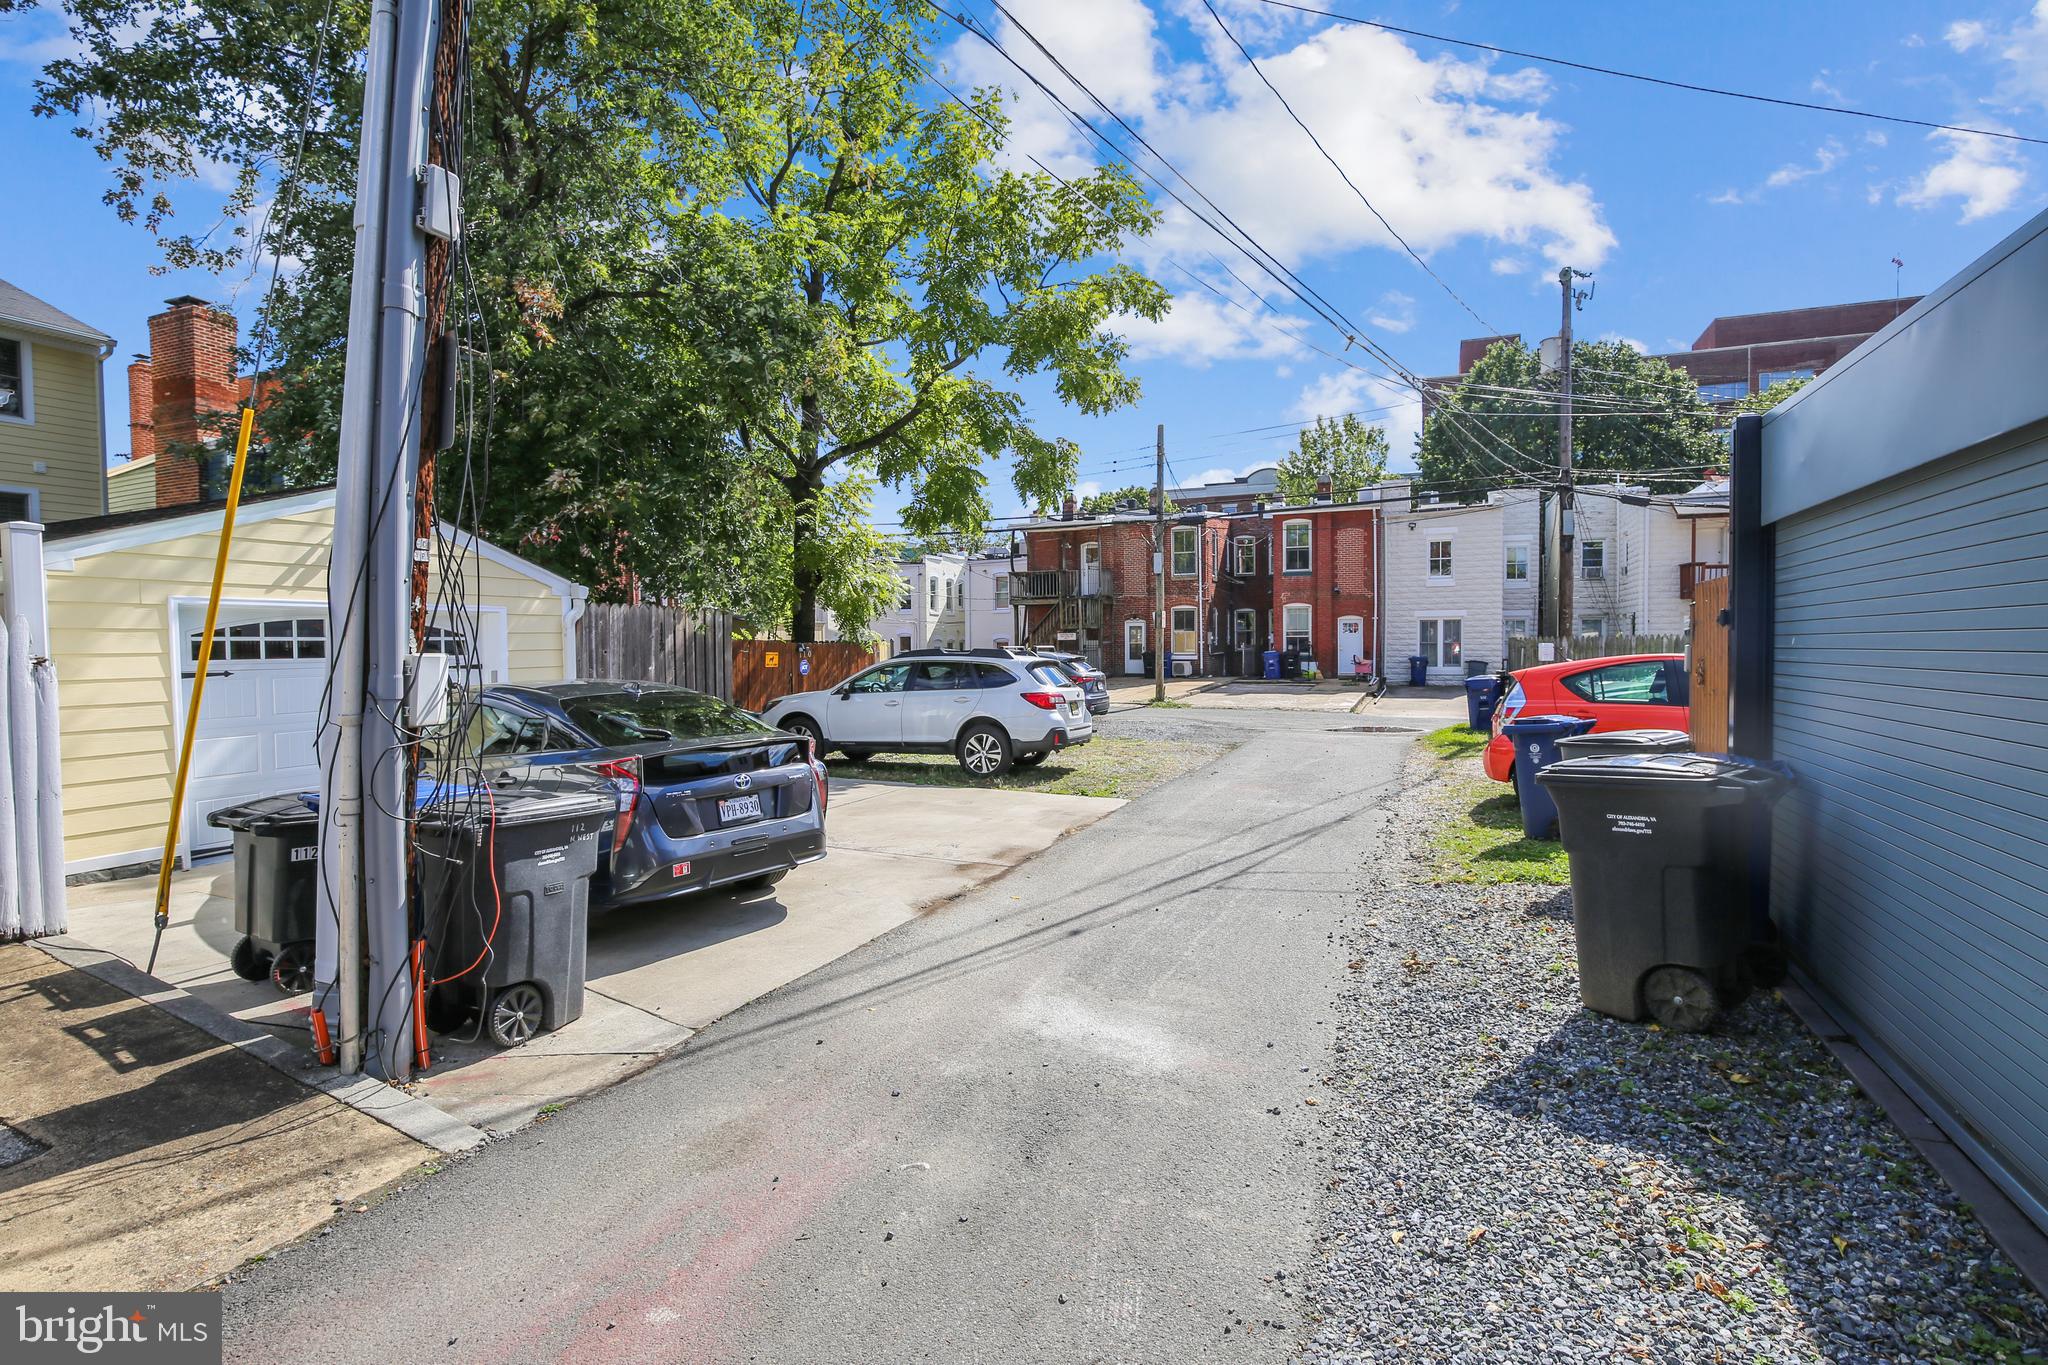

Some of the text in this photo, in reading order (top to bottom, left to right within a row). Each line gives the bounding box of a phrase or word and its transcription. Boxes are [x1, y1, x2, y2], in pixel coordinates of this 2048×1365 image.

[721, 800, 760, 819] VPH-8930
[571, 823, 585, 833] 112
[294, 847, 318, 860] 112
